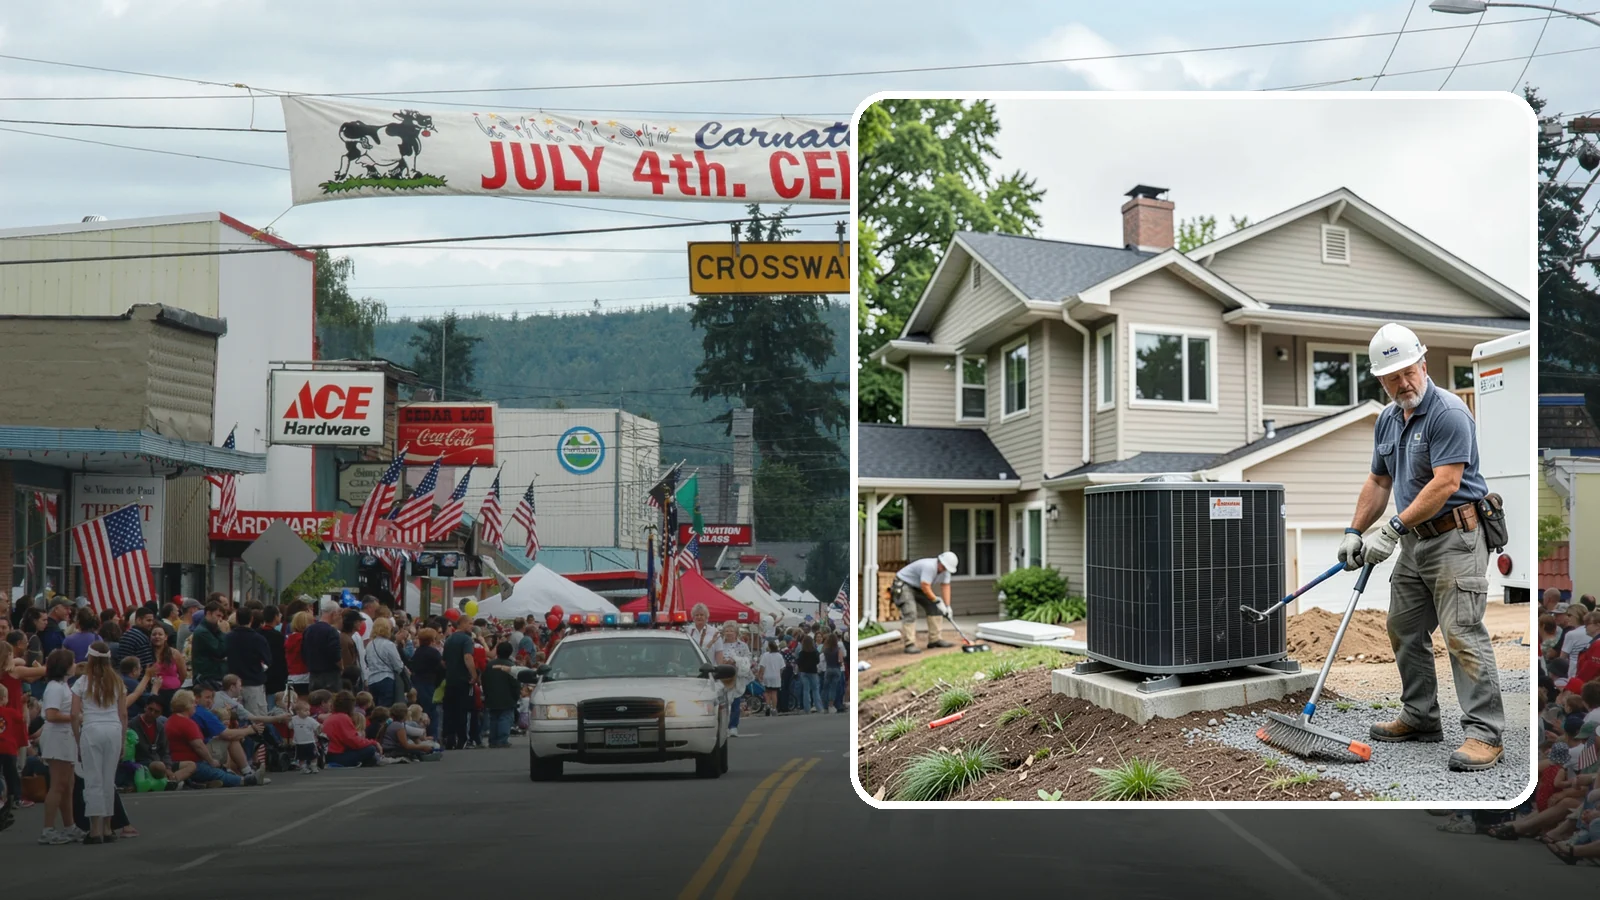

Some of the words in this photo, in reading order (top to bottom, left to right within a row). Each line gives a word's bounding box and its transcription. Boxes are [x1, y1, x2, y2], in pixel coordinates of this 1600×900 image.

[481, 140, 605, 193] JULY
[632, 150, 747, 199] 4th.
[697, 254, 850, 280] CROSSWA
[283, 380, 374, 420] ACE
[405, 409, 453, 422] CEDAR
[461, 409, 485, 422] LOG
[283, 421, 371, 437] Hardware
[416, 428, 477, 447] Coca-Cola
[95, 484, 125, 495] Vincent
[126, 486, 136, 495] de
[137, 486, 155, 495] Paul
[688, 526, 742, 535] CRNATION
[699, 535, 730, 543] GLASS
